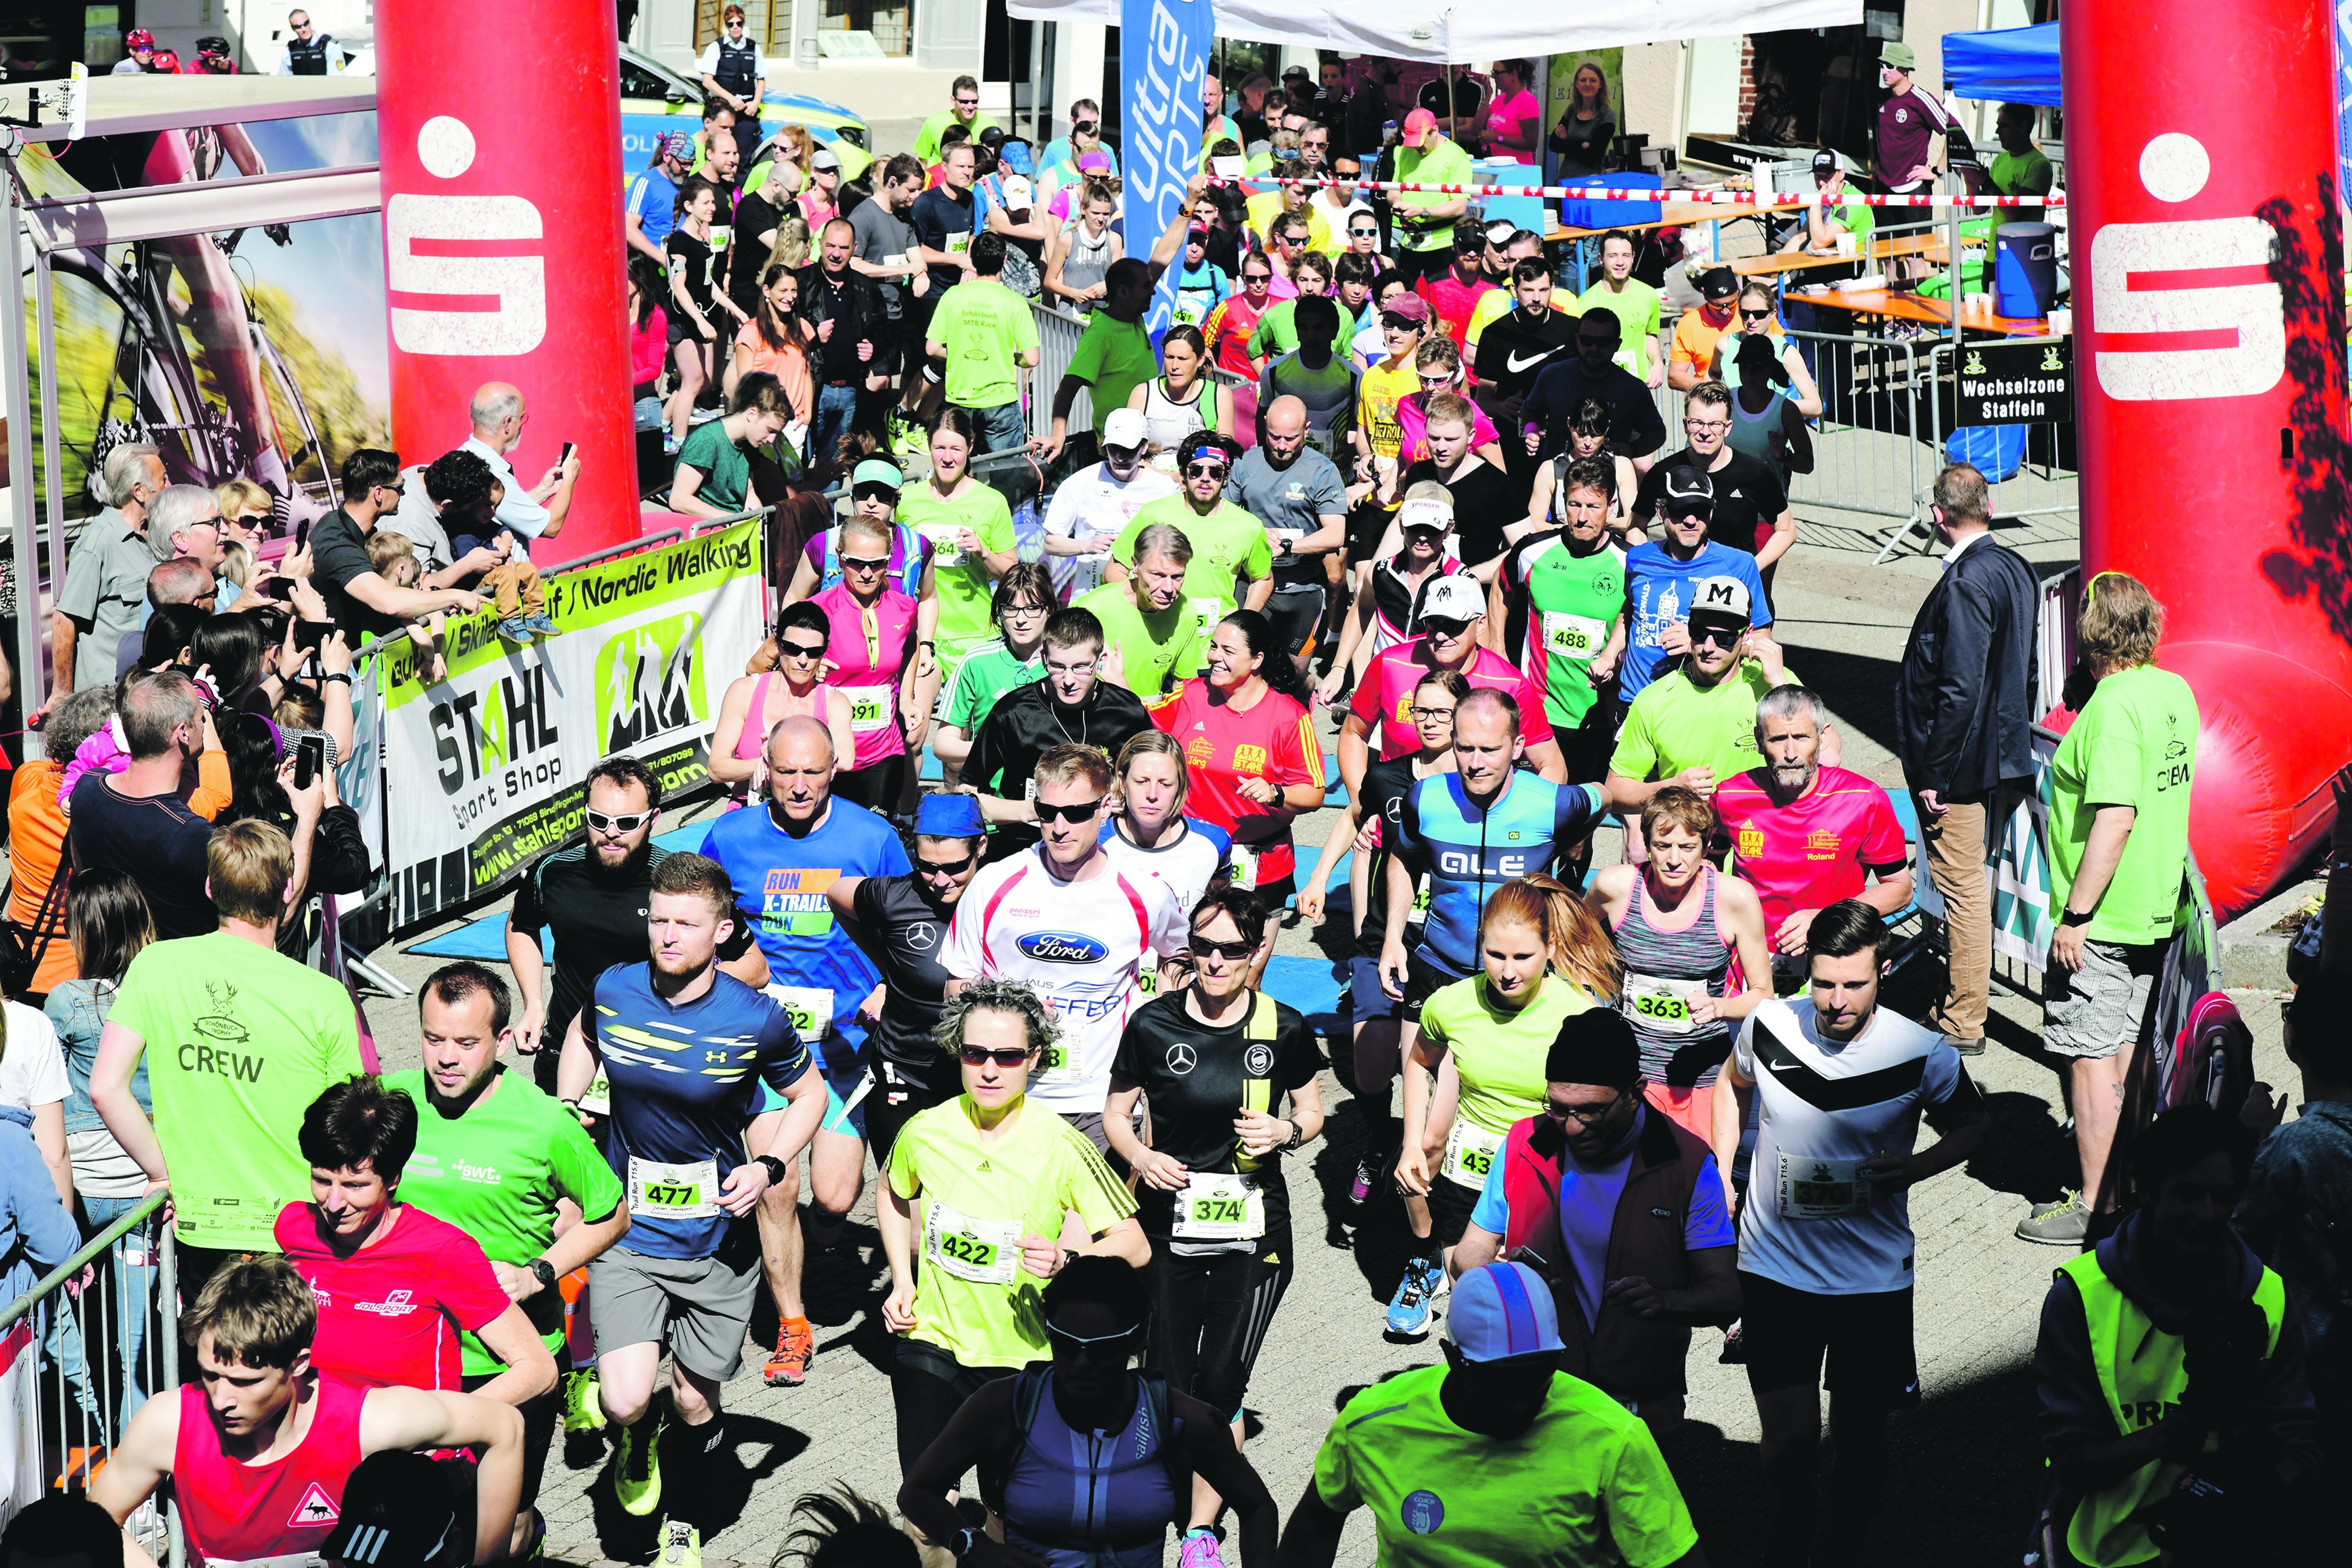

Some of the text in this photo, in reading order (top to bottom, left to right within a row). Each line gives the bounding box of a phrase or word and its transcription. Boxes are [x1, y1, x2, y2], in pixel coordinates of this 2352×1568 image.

[1130, 0, 1179, 203] ultra
[953, 243, 967, 252] 390
[961, 310, 998, 319] Schönbuch
[963, 319, 997, 328] MTB Race
[1962, 377, 2065, 397] Wechselzone
[1982, 400, 2045, 419] Staffeln
[581, 563, 658, 610] Nordic
[667, 537, 752, 584] Walking
[1706, 583, 1735, 606] M
[1554, 632, 1586, 648] 488
[428, 662, 559, 796] STAHL
[1188, 756, 1207, 769] Jörg
[1233, 758, 1263, 773] STAHL
[2157, 763, 2190, 792] CEW
[452, 757, 562, 831] Sport Shop
[1740, 846, 1763, 855] STAHL
[1807, 852, 1835, 861] Roland
[767, 872, 802, 890] RUN
[763, 893, 831, 912] X-TRAILS
[1032, 934, 1091, 960] Ford
[1639, 998, 1682, 1019] 363
[205, 1020, 238, 1031] SCHÖNBUCH
[211, 1028, 231, 1036] TROPHY
[178, 1044, 264, 1083] CREW
[648, 1186, 692, 1204] 477
[1797, 1183, 1846, 1204] 370
[929, 1204, 940, 1227] T15,6
[1196, 1200, 1239, 1221] 374
[943, 1236, 990, 1265] 422
[355, 1302, 418, 1314] JOLSPORT
[1135, 1406, 1151, 1460] sailfish
